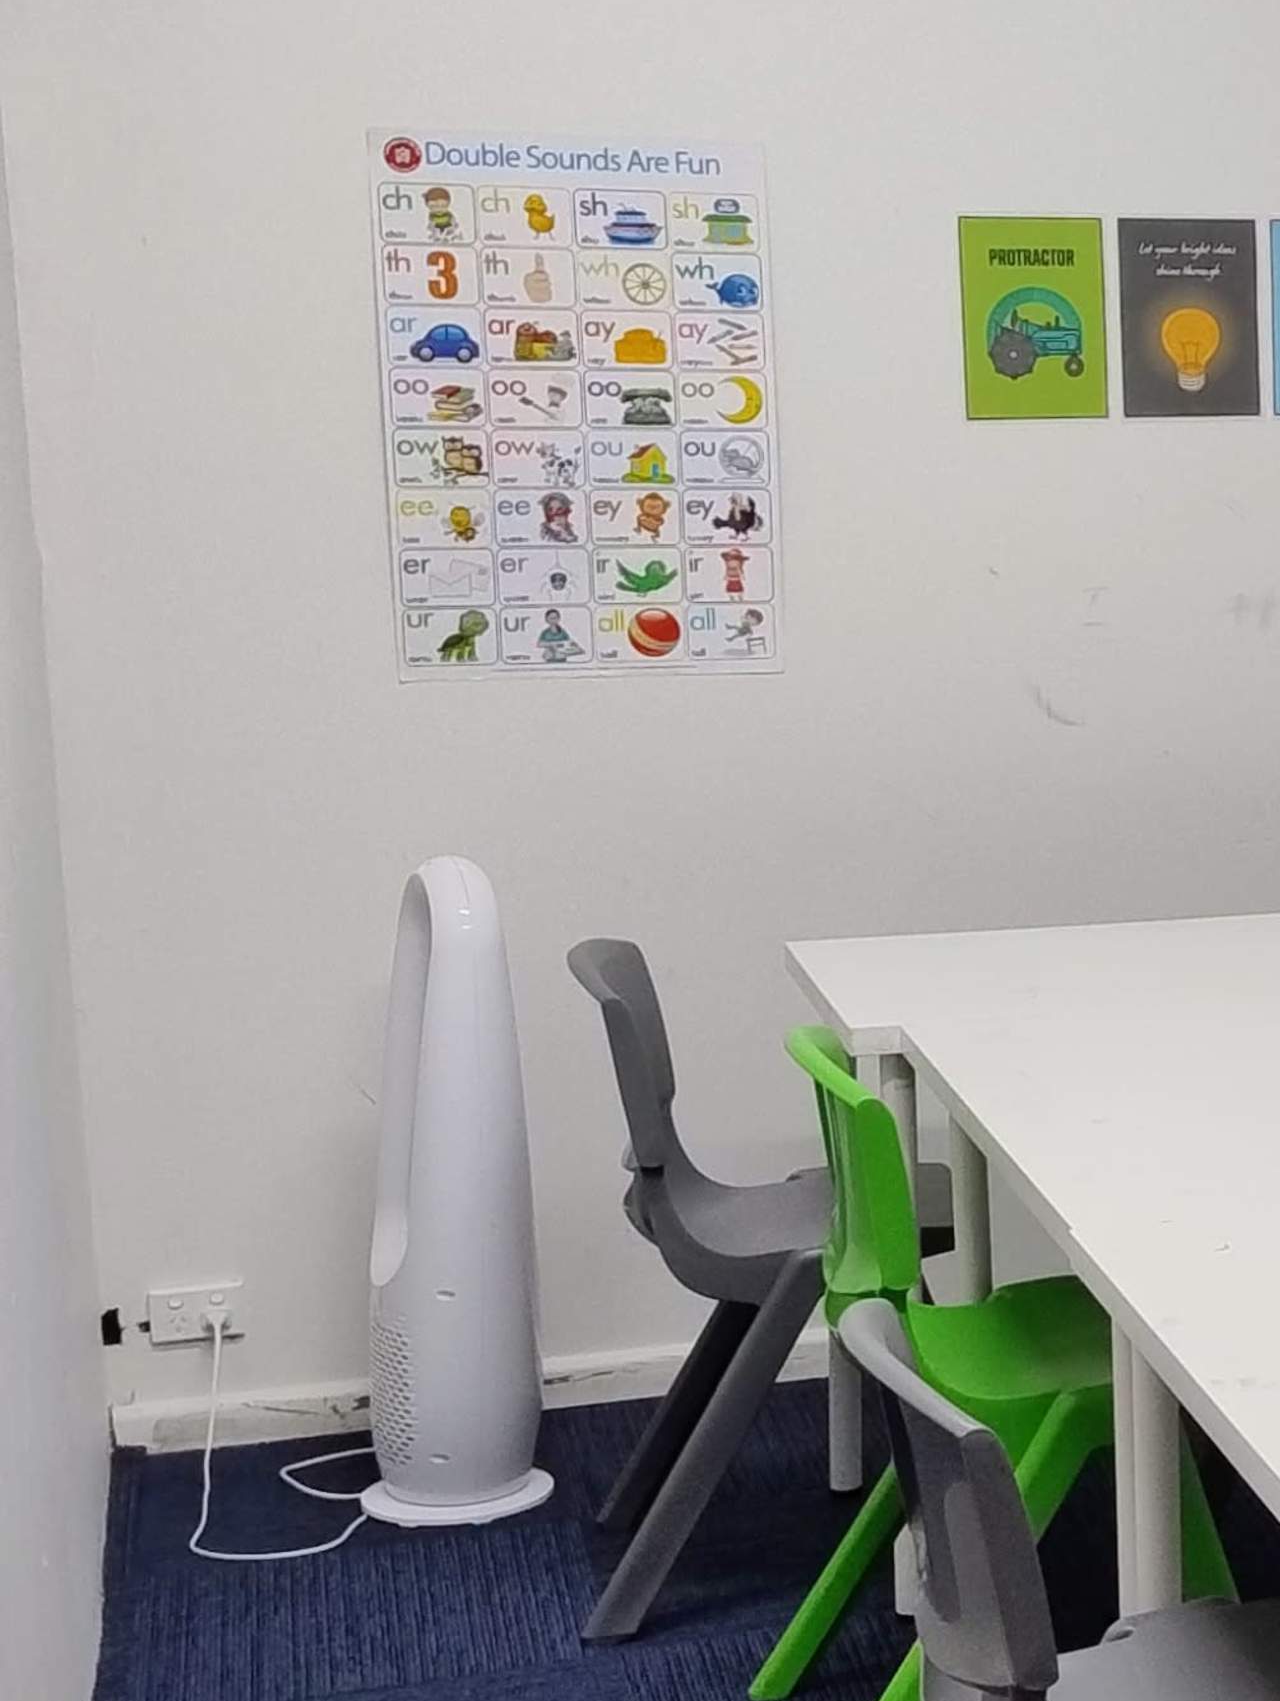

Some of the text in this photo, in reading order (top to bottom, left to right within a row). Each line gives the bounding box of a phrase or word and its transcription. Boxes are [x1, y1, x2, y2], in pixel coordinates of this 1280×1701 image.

[425, 141, 721, 176] Double Sounds Are Fun
[382, 185, 412, 211] ch
[480, 187, 510, 214] ch
[579, 192, 608, 217] sh
[671, 195, 699, 220] sh
[385, 249, 411, 273] th
[484, 251, 509, 275] th
[579, 254, 620, 277] wh
[988, 248, 1075, 267] PROTRACTOR
[426, 250, 459, 300] 3
[675, 256, 715, 280] wh
[389, 316, 417, 334] ar
[488, 318, 516, 336] ar
[584, 320, 616, 343] ay
[678, 322, 708, 344] ay
[393, 378, 429, 395] oo
[491, 379, 527, 396] oo
[587, 381, 622, 397] oo
[681, 382, 715, 398] oo
[396, 439, 439, 456] ow
[494, 440, 535, 456] ow
[590, 441, 623, 457] ou
[684, 441, 716, 457] ou
[400, 499, 434, 516] ee
[497, 499, 531, 516] ee
[593, 499, 622, 522] ey
[686, 499, 715, 521] ey
[403, 557, 431, 575] er
[500, 557, 529, 574] er
[688, 550, 704, 573] ir
[406, 612, 434, 629] ur
[503, 615, 531, 633] ur
[598, 608, 625, 632] all
[690, 607, 716, 632] all
